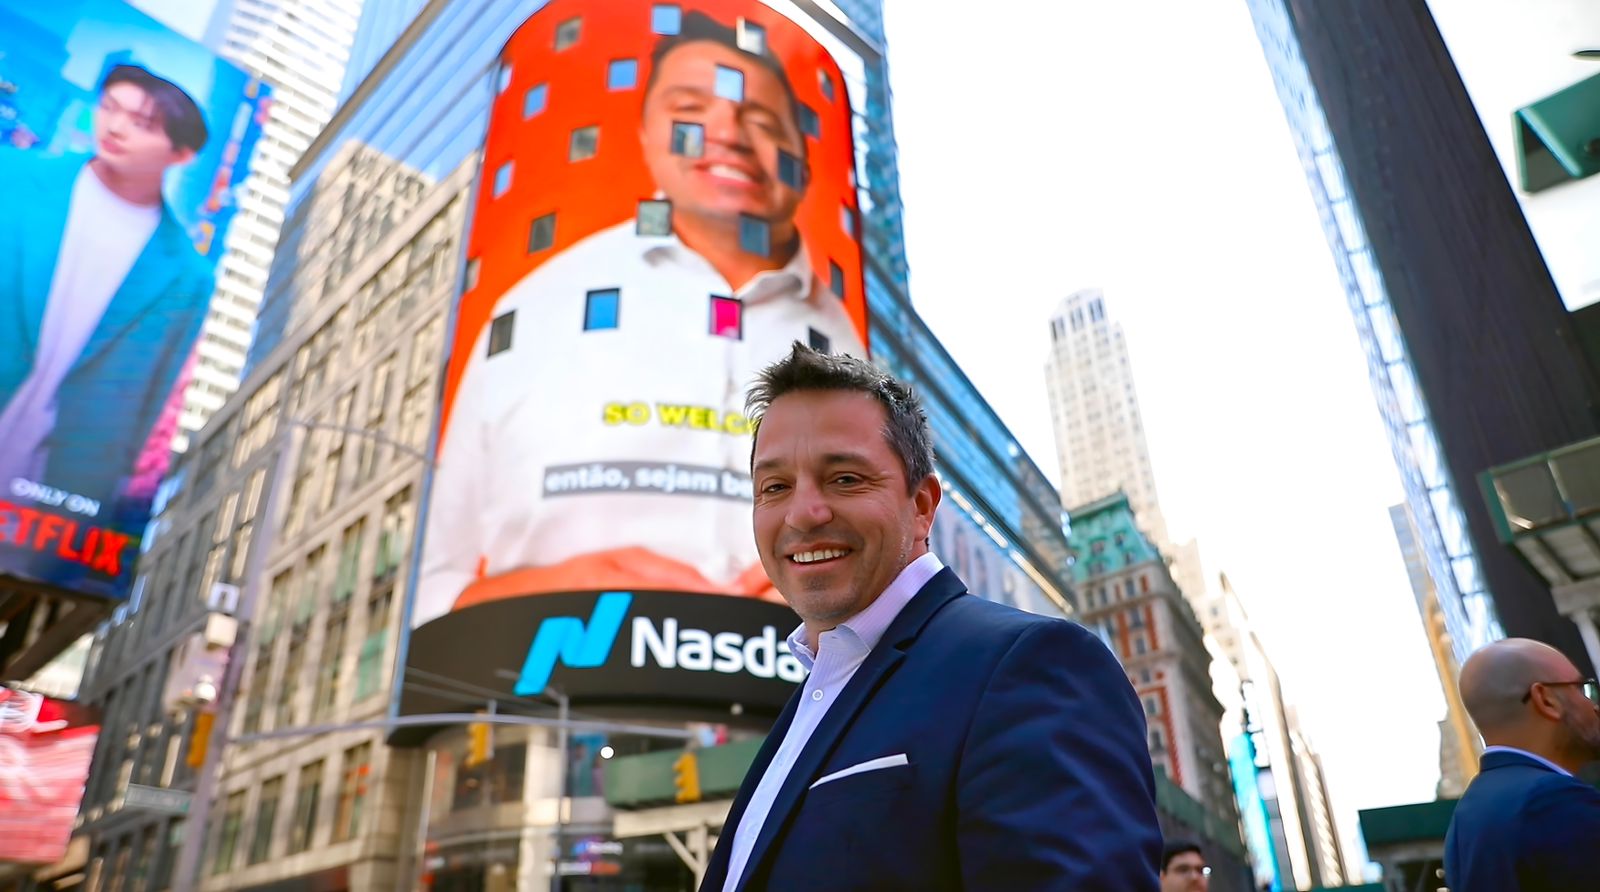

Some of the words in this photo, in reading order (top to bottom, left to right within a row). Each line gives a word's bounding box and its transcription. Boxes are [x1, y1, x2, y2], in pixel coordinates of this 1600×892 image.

[603, 402, 650, 425] SO
[545, 464, 629, 491] então,
[635, 464, 717, 492] sejam
[10, 477, 68, 506] ONLY
[64, 493, 100, 516] ON
[631, 617, 807, 683] Nasda
